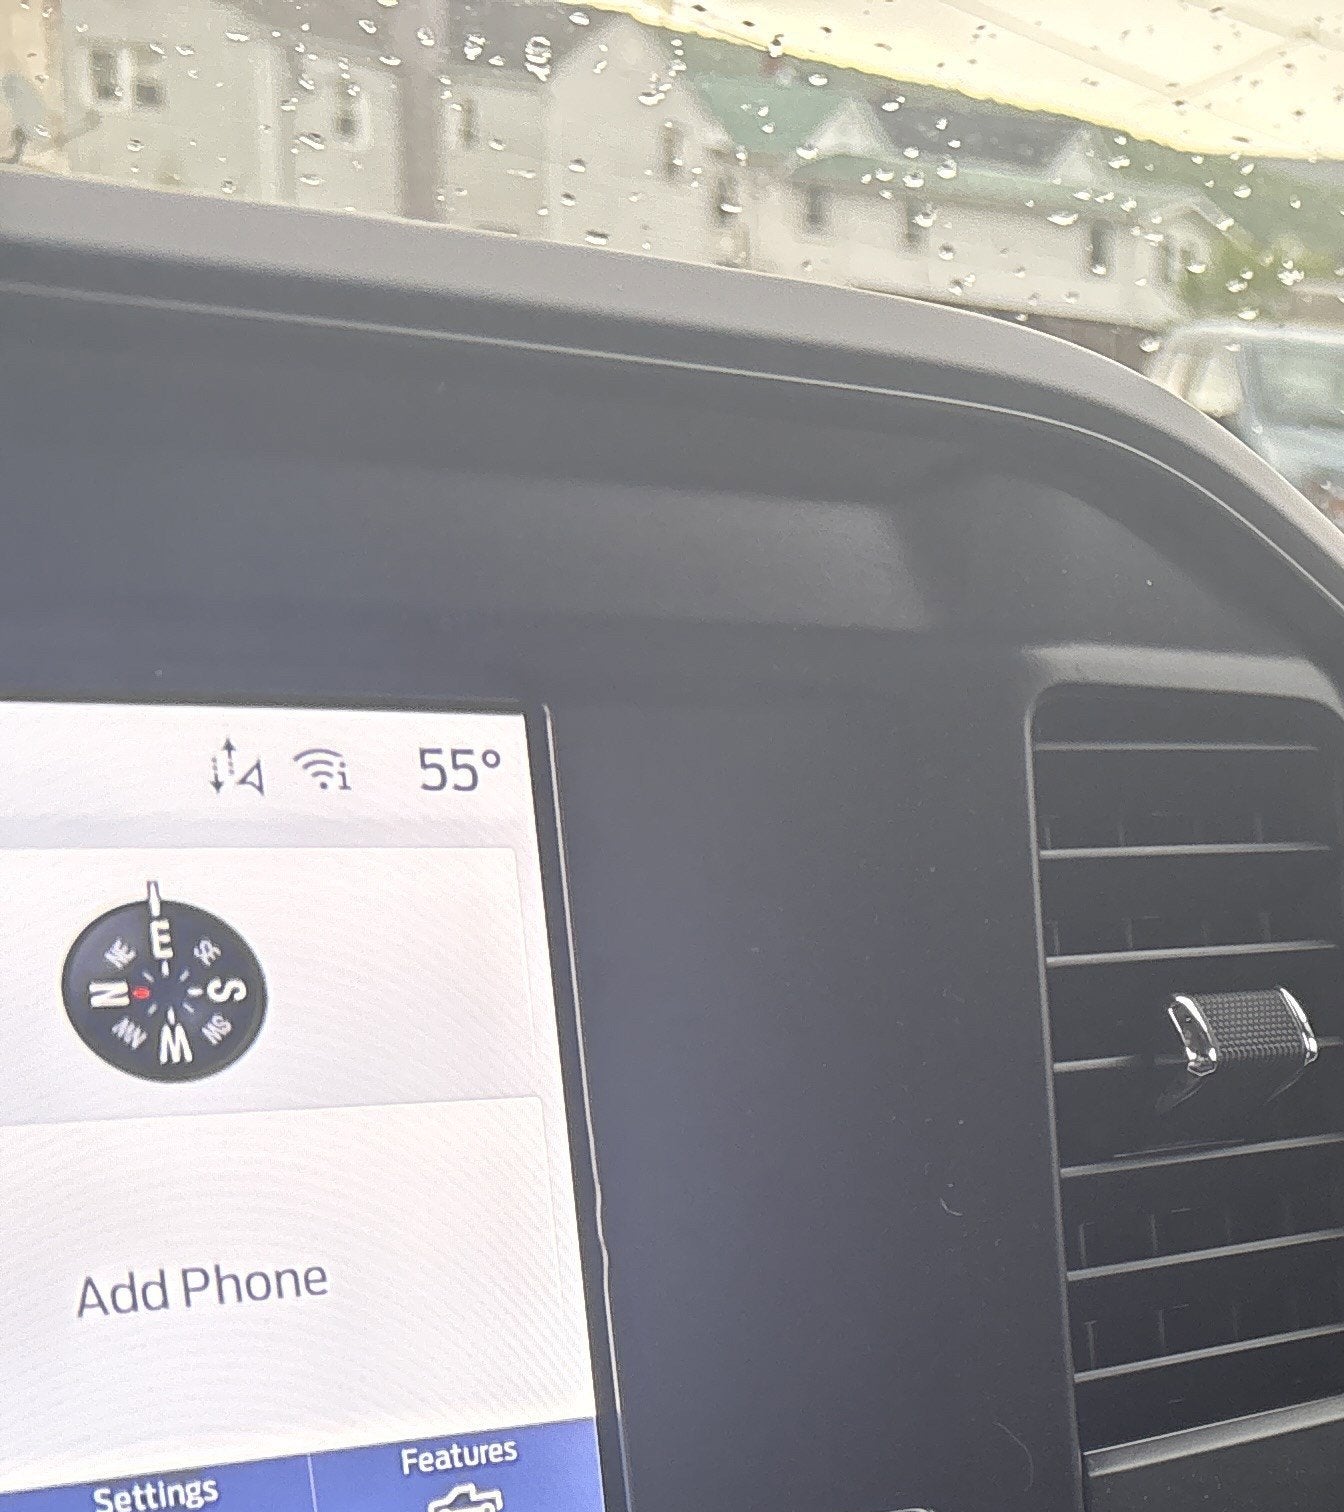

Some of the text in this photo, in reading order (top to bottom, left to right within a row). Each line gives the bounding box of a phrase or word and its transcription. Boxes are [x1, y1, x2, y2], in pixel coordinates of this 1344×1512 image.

[419, 747, 501, 792] 55°
[150, 918, 174, 960] E
[88, 979, 131, 1008] N
[206, 976, 247, 1003] S
[159, 1022, 194, 1065] W
[78, 1263, 329, 1318] Add Phone
[401, 1439, 519, 1475] Features
